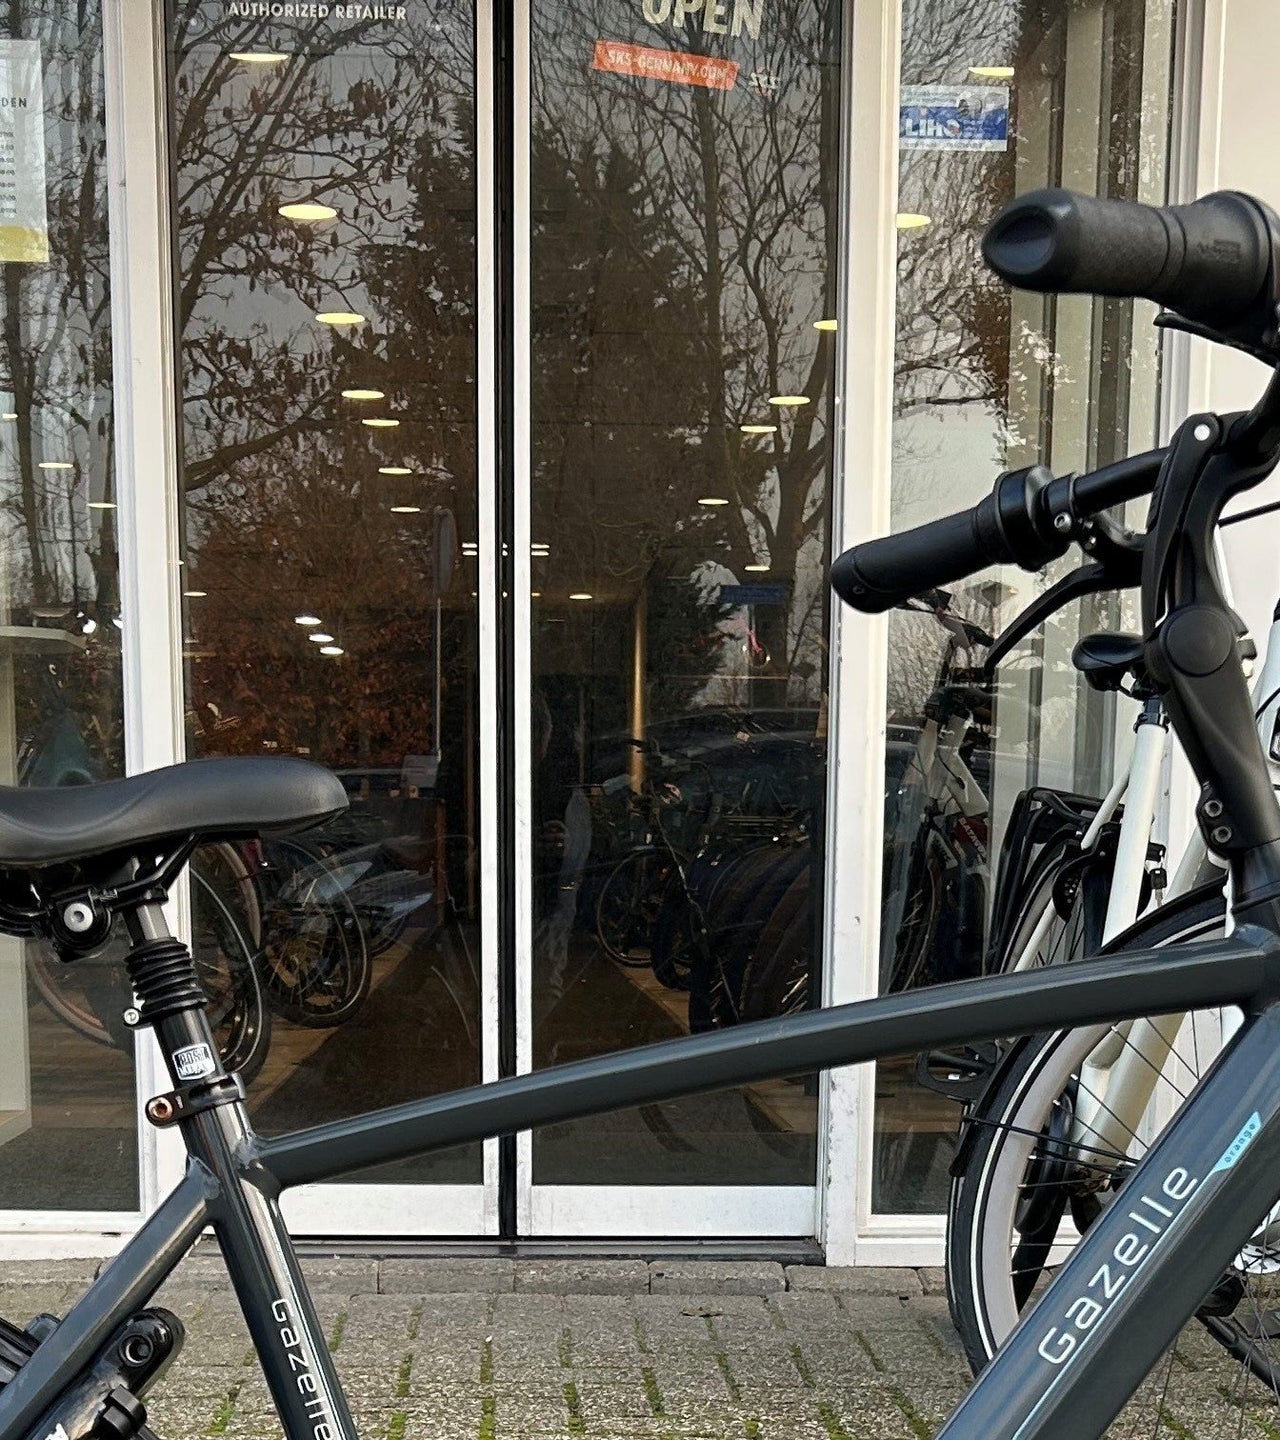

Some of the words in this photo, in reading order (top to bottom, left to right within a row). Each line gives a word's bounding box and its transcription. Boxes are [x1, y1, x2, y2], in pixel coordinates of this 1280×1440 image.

[228, 2, 330, 18] AUTHORIZED
[335, 4, 407, 20] RETAILER
[1223, 1122, 1256, 1163] orange
[1037, 1166, 1198, 1365] Gazelle
